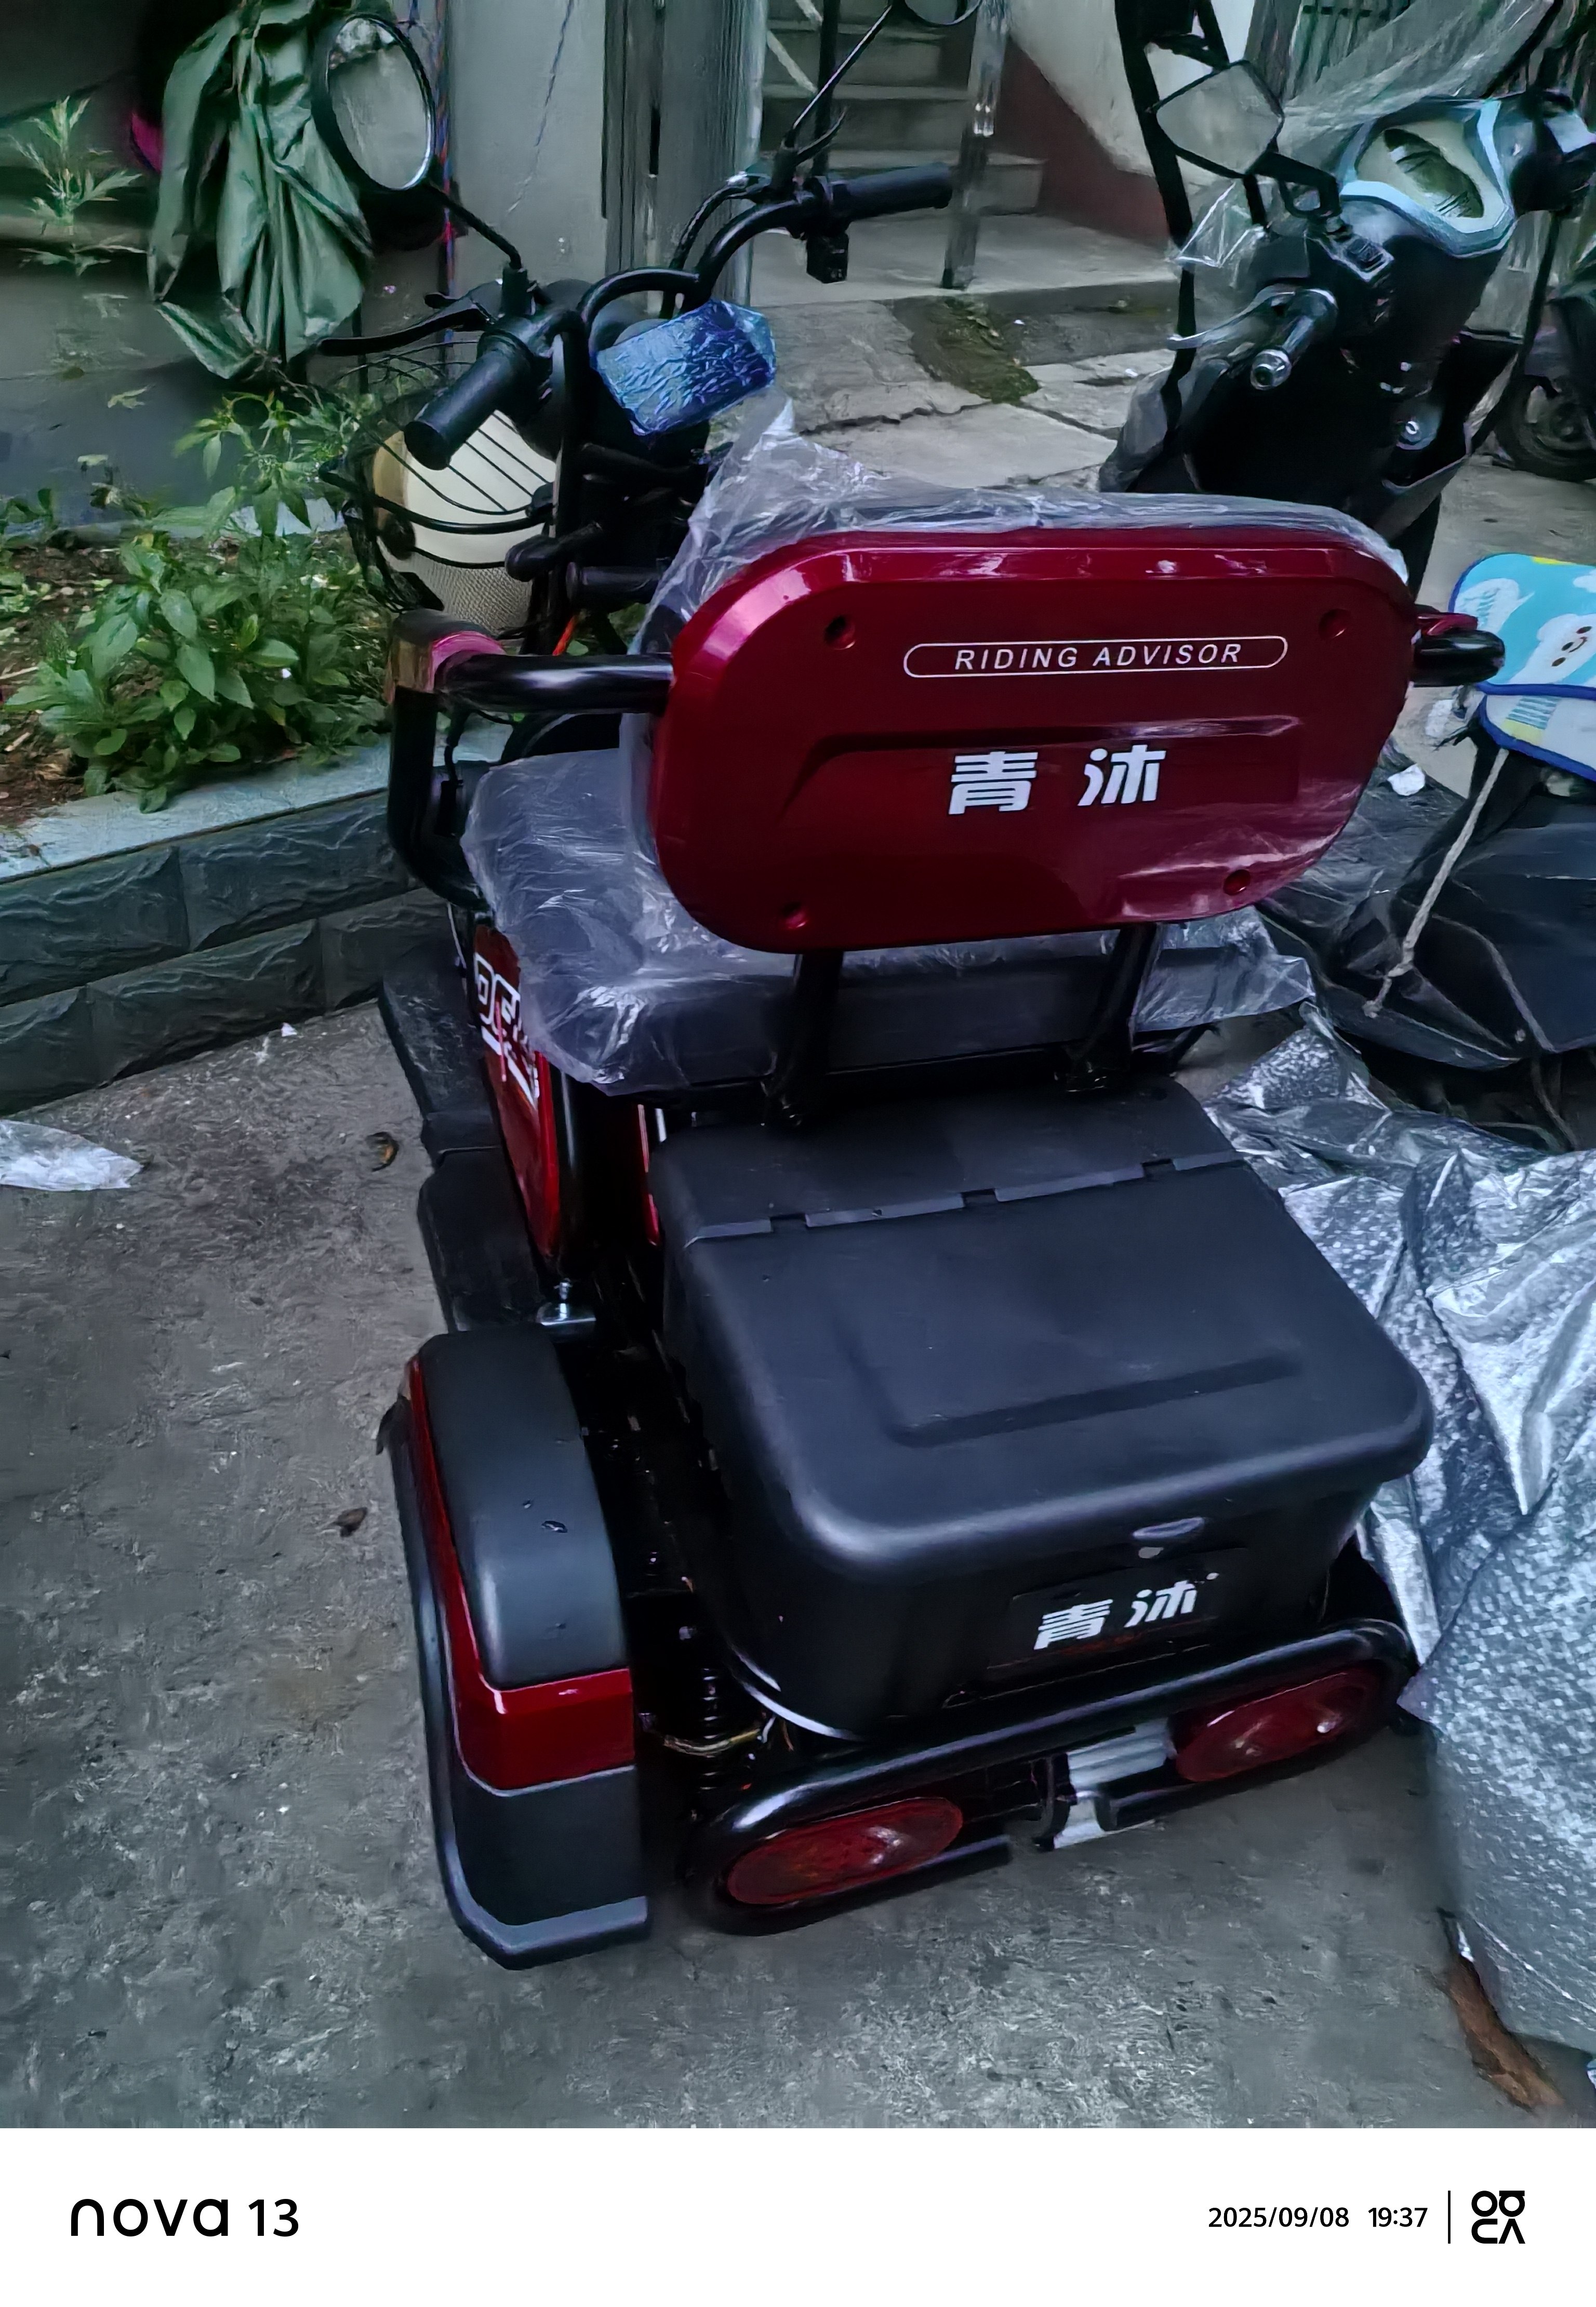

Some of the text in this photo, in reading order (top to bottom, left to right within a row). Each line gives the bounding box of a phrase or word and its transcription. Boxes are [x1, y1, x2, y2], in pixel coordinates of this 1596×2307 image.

[955, 643, 1243, 671] RIDING ADVISOR
[948, 744, 1167, 815] 青沐
